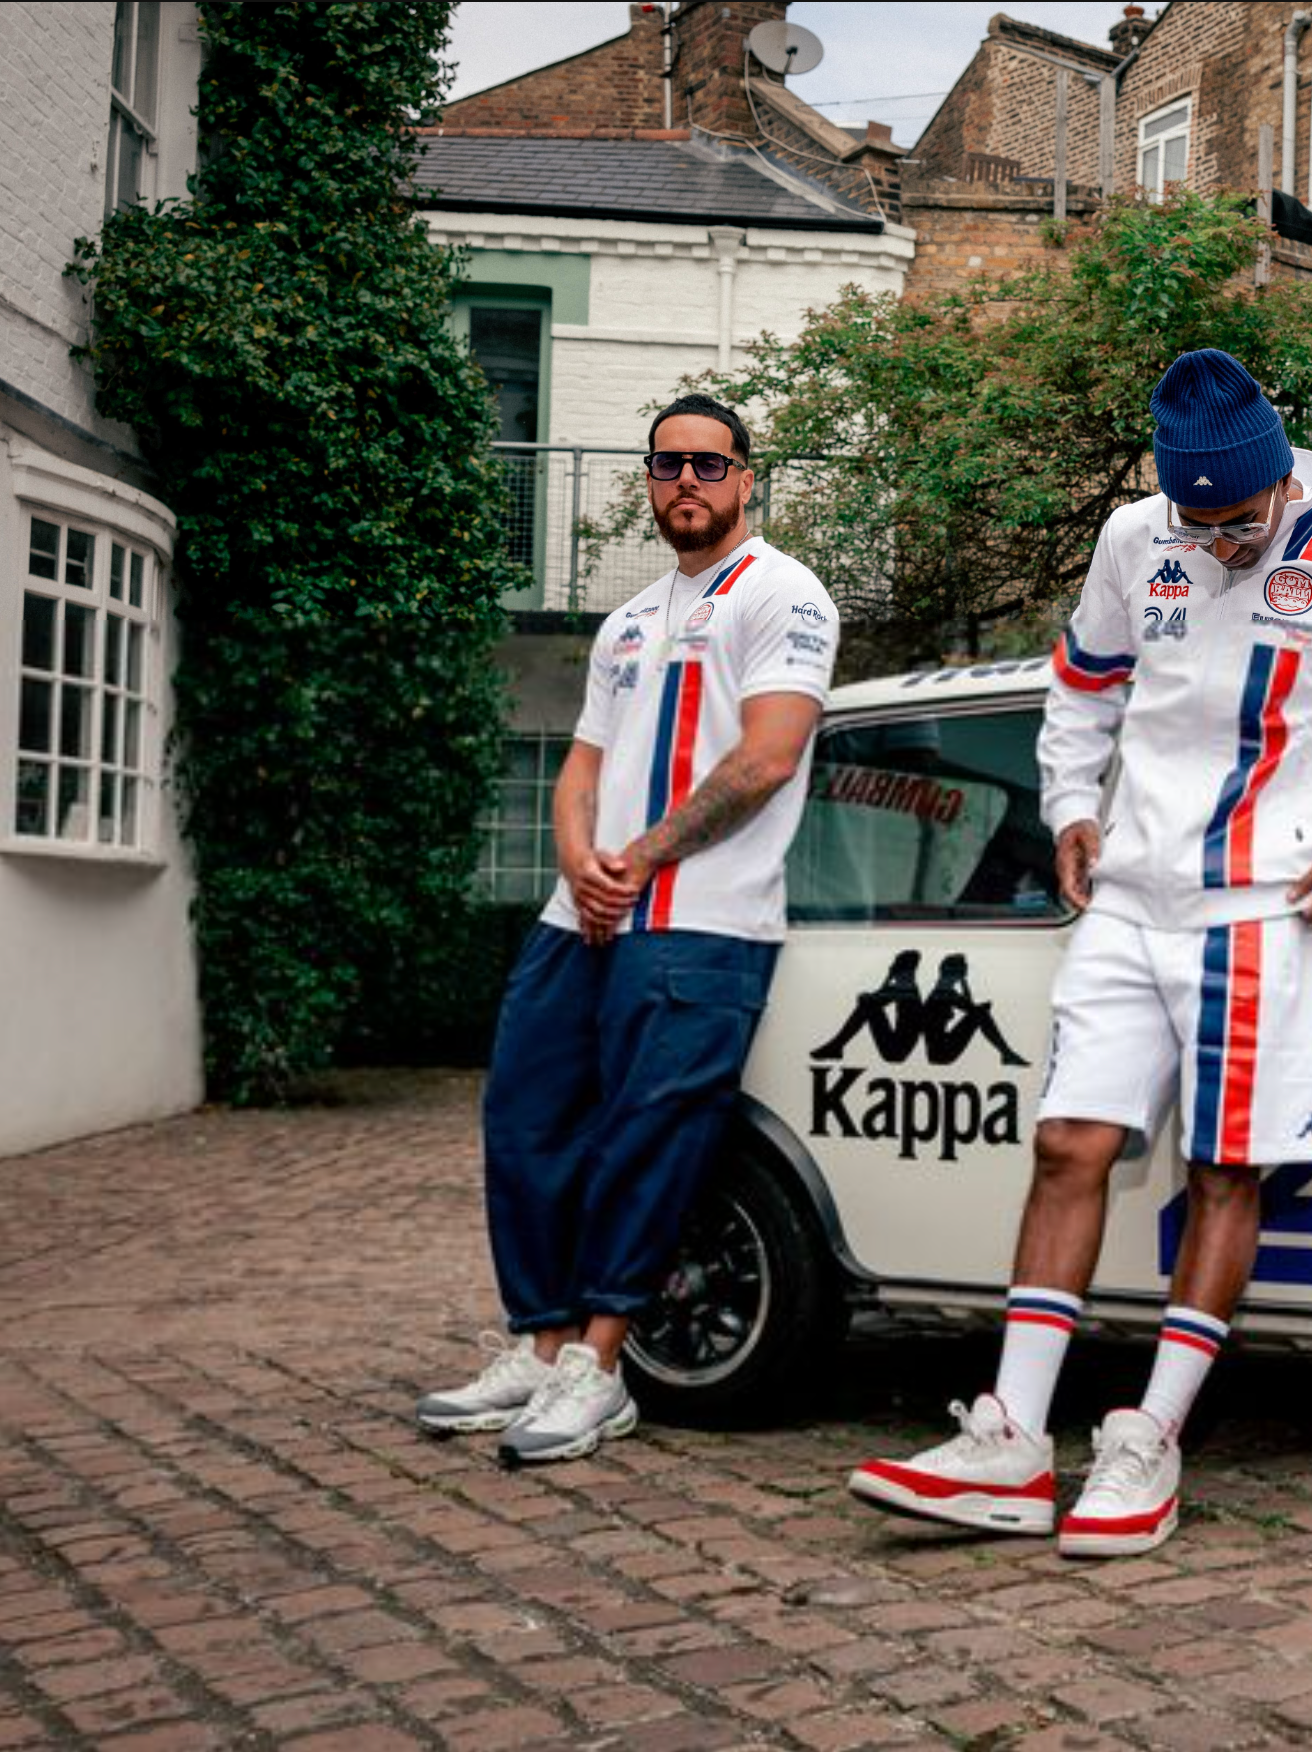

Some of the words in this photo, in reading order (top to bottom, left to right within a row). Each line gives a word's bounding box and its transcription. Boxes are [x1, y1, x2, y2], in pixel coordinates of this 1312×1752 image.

[1274, 574, 1310, 588] GUM
[1148, 583, 1190, 600] Kappa
[1271, 583, 1311, 599] BALL
[791, 605, 812, 616] Hard
[1144, 606, 1188, 641] 24
[809, 1065, 1021, 1160] Kappa
